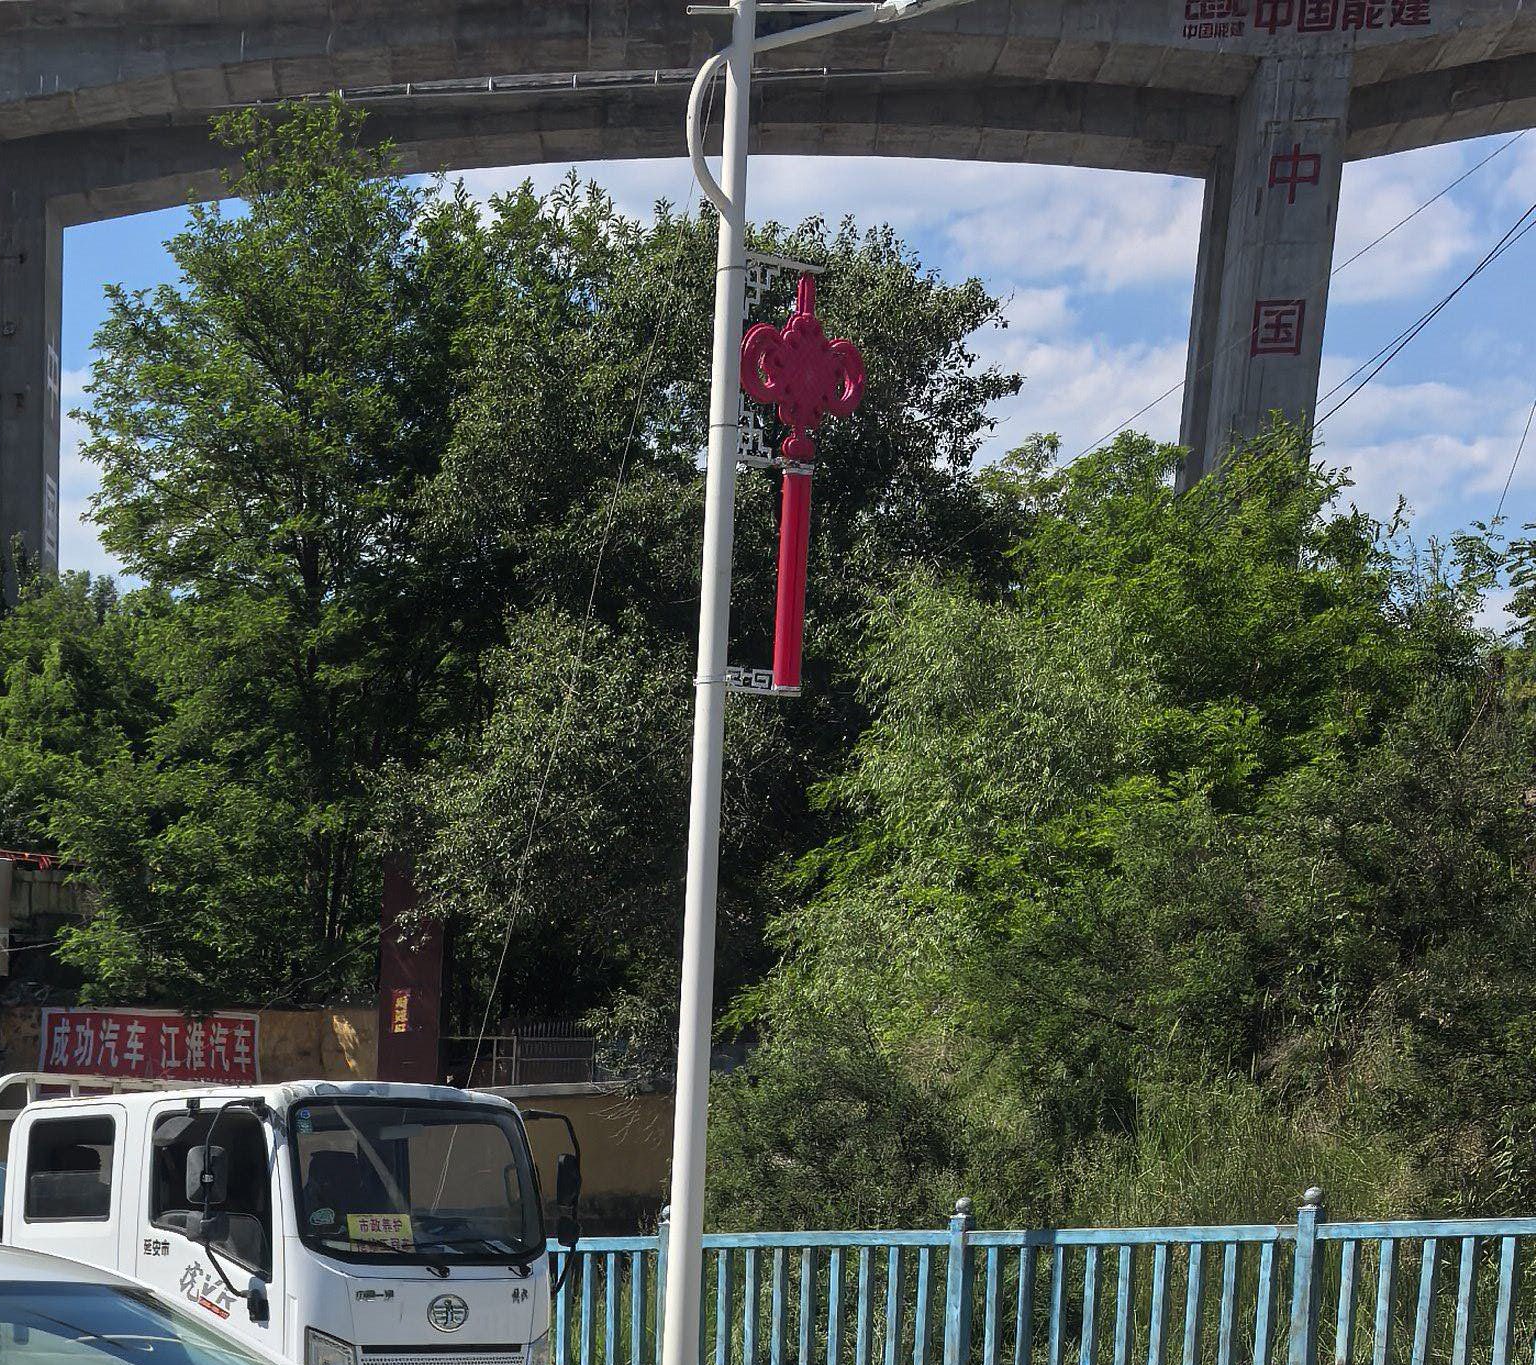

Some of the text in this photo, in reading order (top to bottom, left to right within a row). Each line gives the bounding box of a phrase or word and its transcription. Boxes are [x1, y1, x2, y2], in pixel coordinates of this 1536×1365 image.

[50, 1017, 252, 1073] 成功汽车 江淮汽车
[143, 1238, 170, 1257] 延安市
